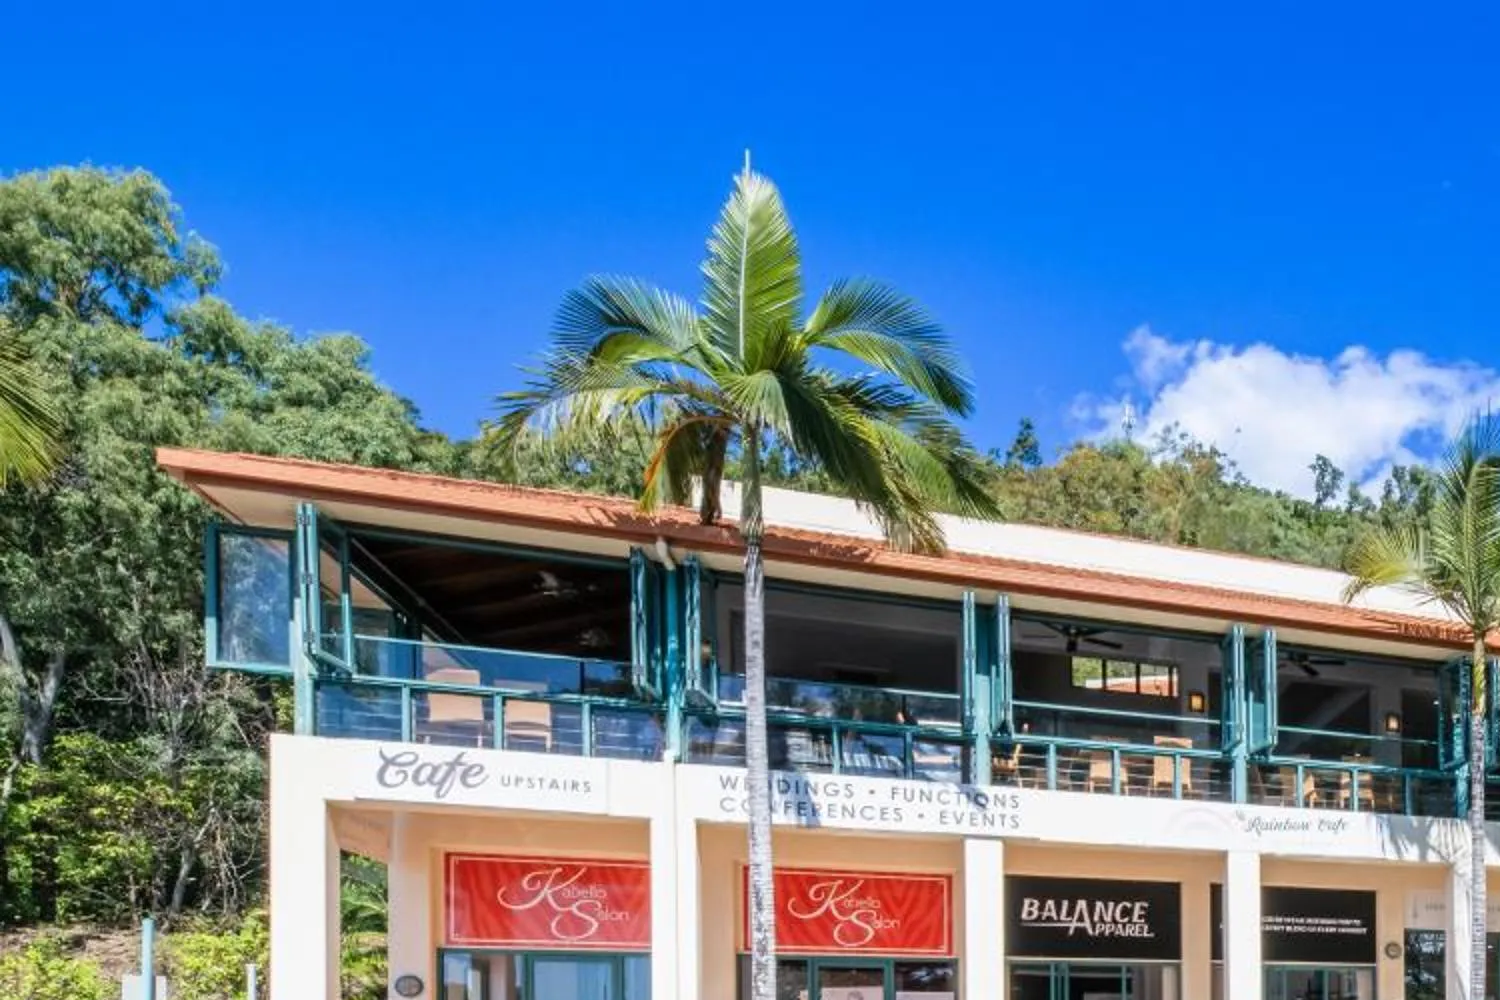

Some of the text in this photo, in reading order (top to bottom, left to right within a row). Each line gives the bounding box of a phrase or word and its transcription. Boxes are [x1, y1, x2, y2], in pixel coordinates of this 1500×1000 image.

[376, 747, 592, 799] Cafe UPSTAIRS
[719, 774, 1020, 809] WDINGS FUNCTIONS
[939, 809, 1020, 829] EVENTS
[1021, 898, 1150, 936] BALANCE
